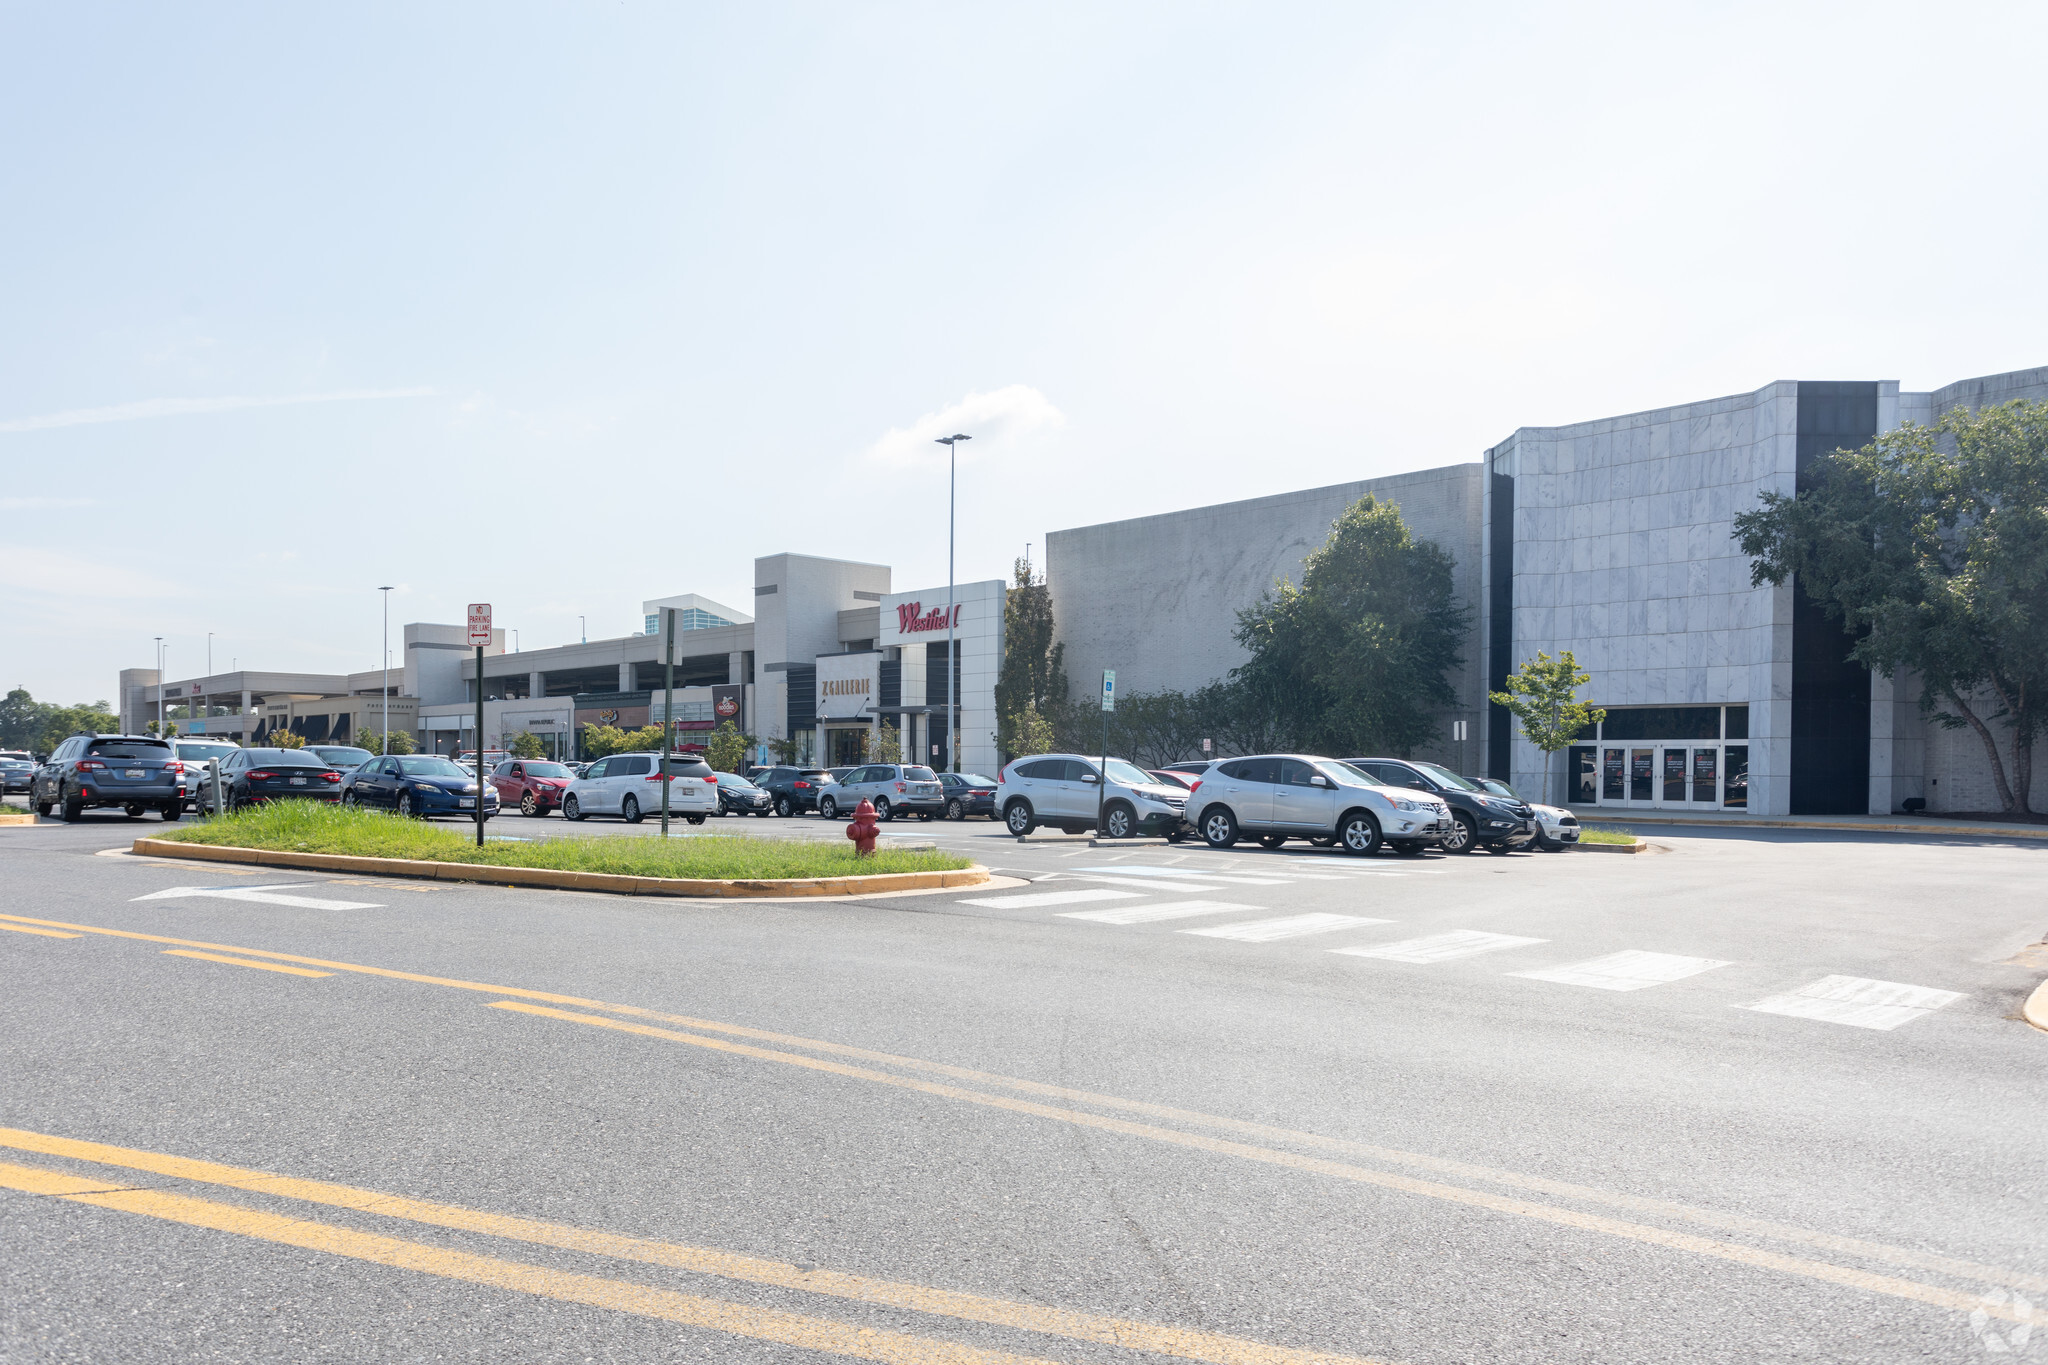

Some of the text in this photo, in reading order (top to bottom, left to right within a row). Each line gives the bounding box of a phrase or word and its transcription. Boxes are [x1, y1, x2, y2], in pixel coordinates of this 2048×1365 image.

[475, 606, 484, 615] NO
[469, 615, 490, 624] PARKING
[469, 624, 490, 632] FIRE LANE
[821, 678, 870, 696] Z GALLERIE
